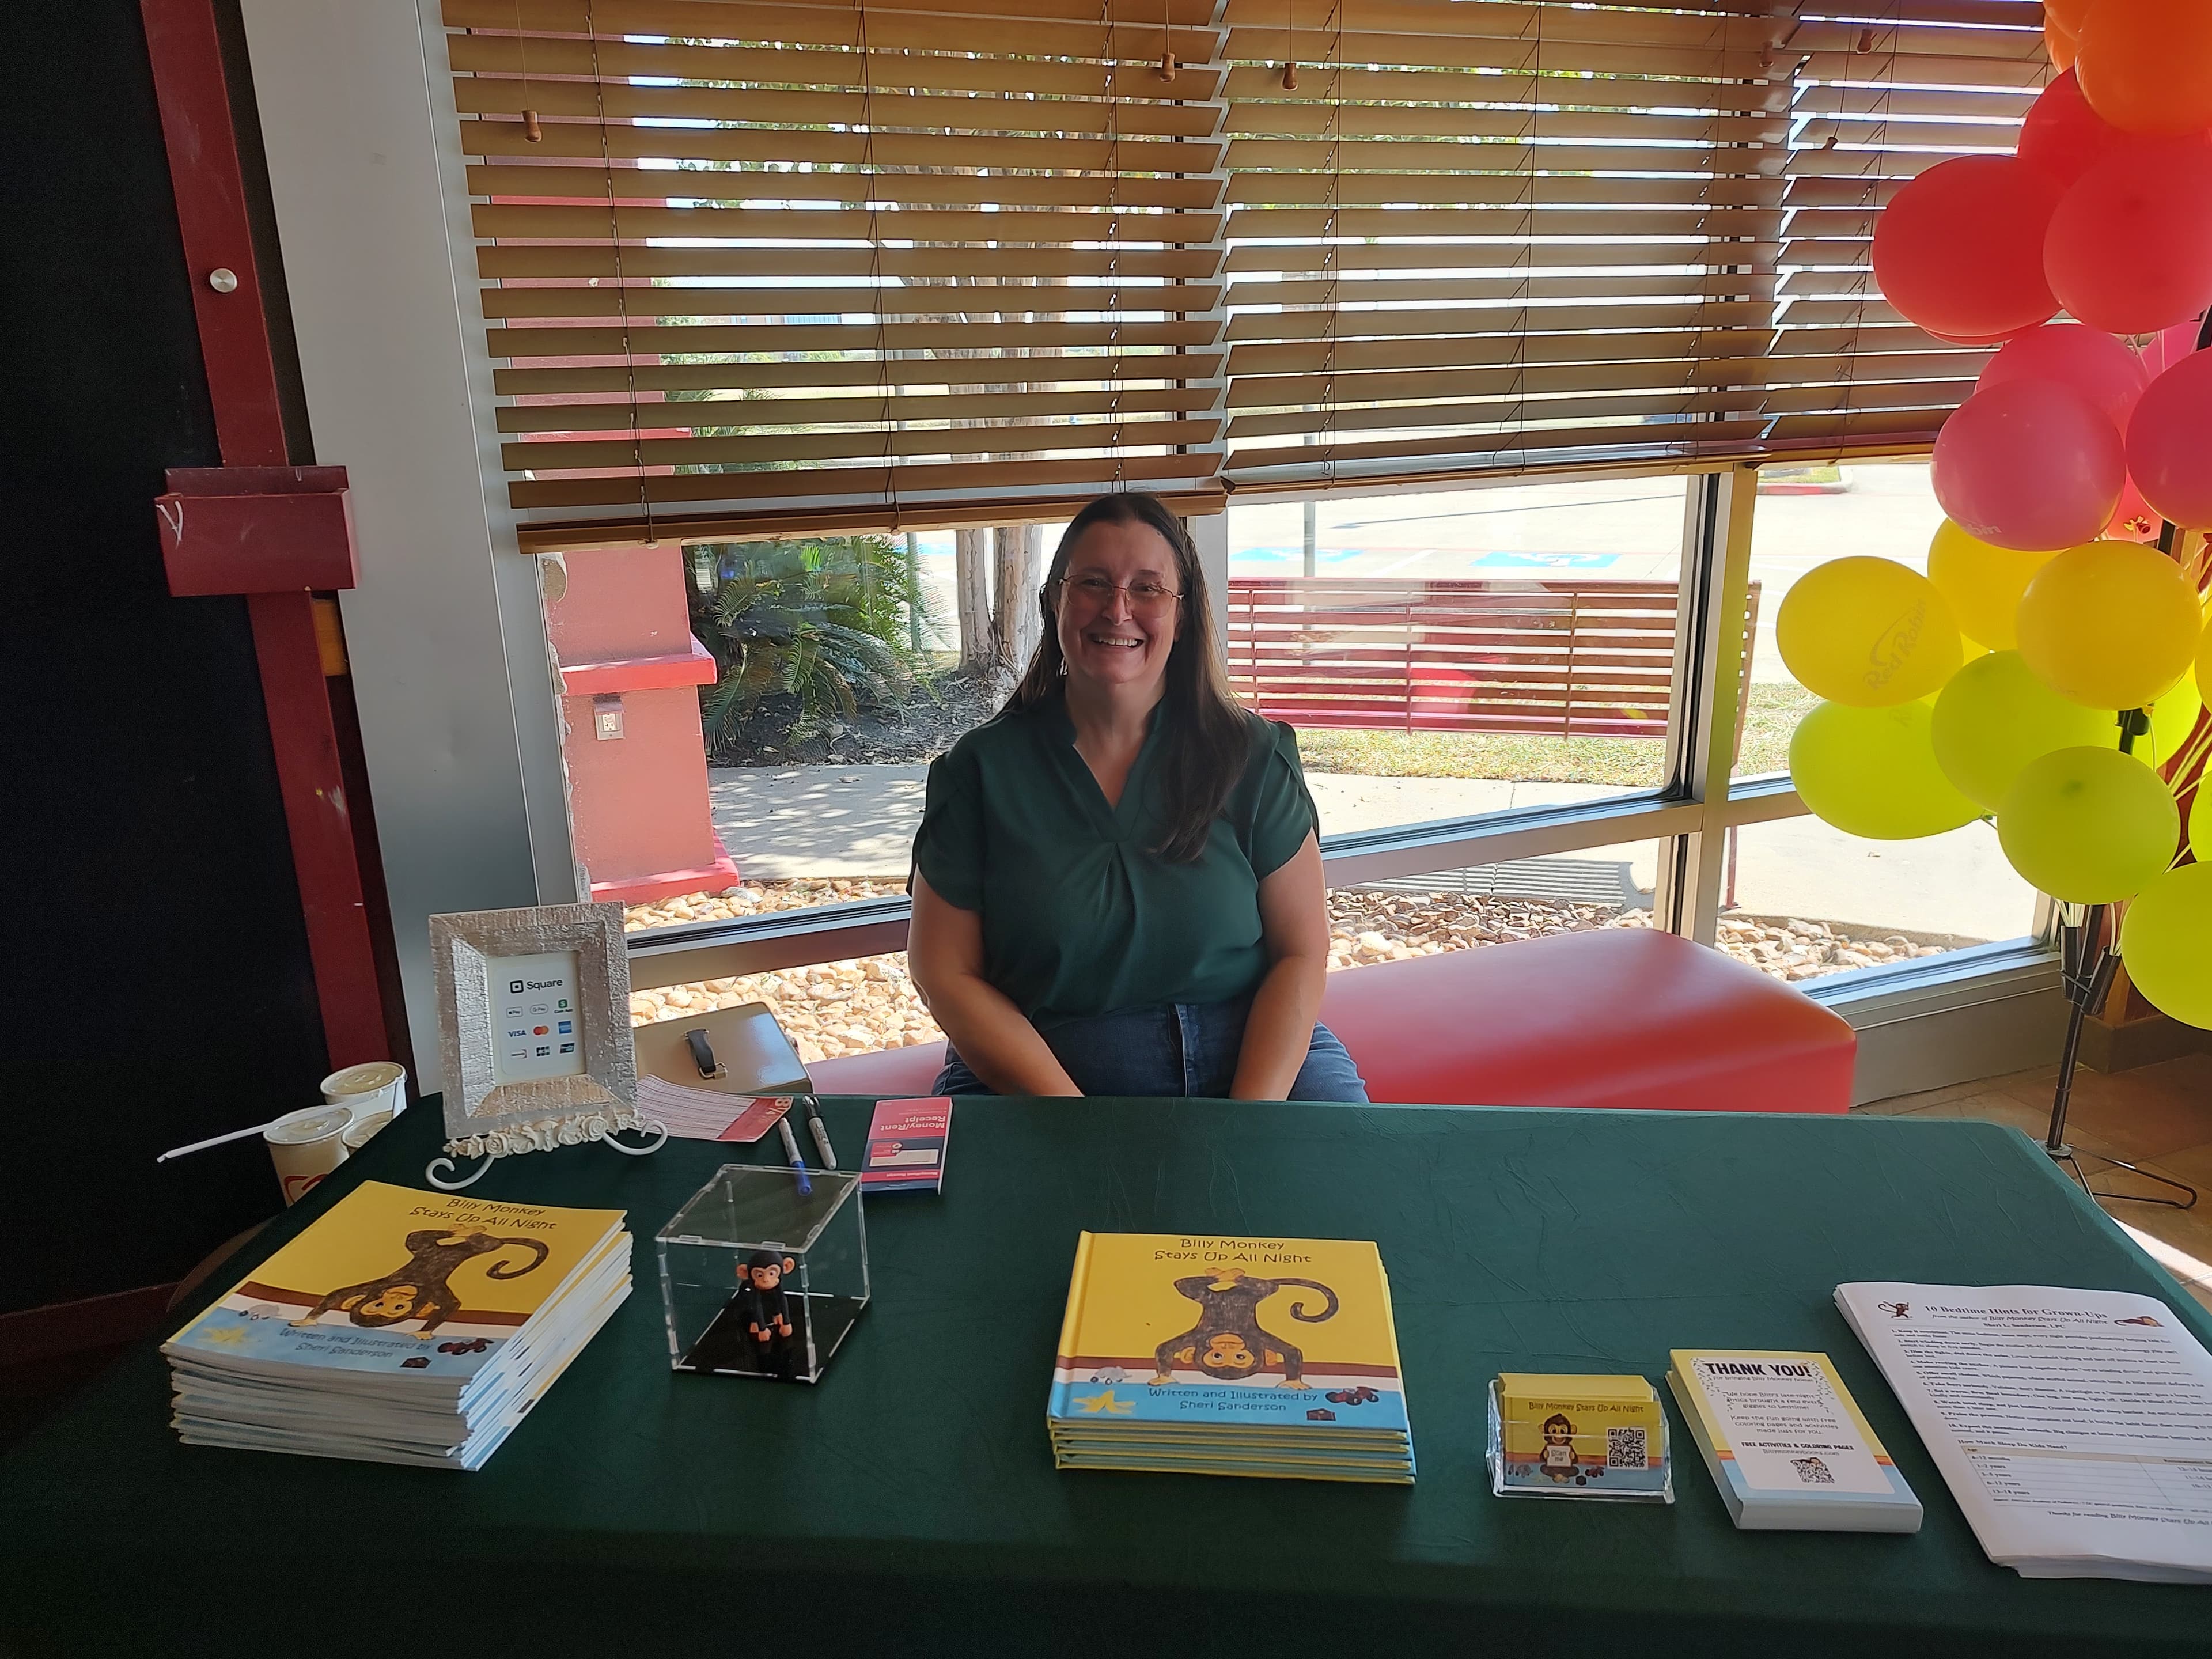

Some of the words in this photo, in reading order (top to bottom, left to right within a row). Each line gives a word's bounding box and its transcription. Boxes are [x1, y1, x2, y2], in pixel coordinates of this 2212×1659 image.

[1861, 652, 1903, 691] Red
[1893, 598, 1927, 658] Robin
[527, 979, 563, 991] Square
[880, 1123, 945, 1131] Money/Rent
[446, 1198, 482, 1210] Billy
[482, 1203, 546, 1217] Monkey
[410, 1206, 454, 1219] Stays
[456, 1213, 480, 1223] Up
[482, 1217, 509, 1226] All
[510, 1218, 557, 1229] Night
[1180, 1238, 1214, 1248] Billy
[1219, 1240, 1285, 1250] Monkey
[1154, 1251, 1198, 1260] Stays
[1204, 1252, 1228, 1262] Up
[1232, 1252, 1257, 1262] All
[1264, 1253, 1312, 1263] Night
[1940, 1306, 1986, 1315] Bedtime
[2041, 1309, 2108, 1319] Grown-Ups
[279, 1328, 327, 1340] Written
[327, 1335, 350, 1344] and
[350, 1336, 416, 1349] Illustrated
[295, 1342, 330, 1352] Sheri
[328, 1346, 393, 1357] Sanderson
[1705, 1363, 1767, 1376] THANK
[1768, 1364, 1813, 1377] YOU!
[1149, 1388, 1198, 1397] Written
[1203, 1389, 1226, 1398] and
[1231, 1391, 1300, 1400] Illustrated
[1303, 1393, 1317, 1402] by
[1180, 1400, 1213, 1410] Sheri
[1218, 1402, 1286, 1411] Sanderson
[1529, 1402, 1544, 1411] Billy
[1546, 1403, 1574, 1411] Monkey
[1576, 1403, 1596, 1412] Stays
[1597, 1404, 1608, 1412] Up
[1611, 1404, 1621, 1412] All
